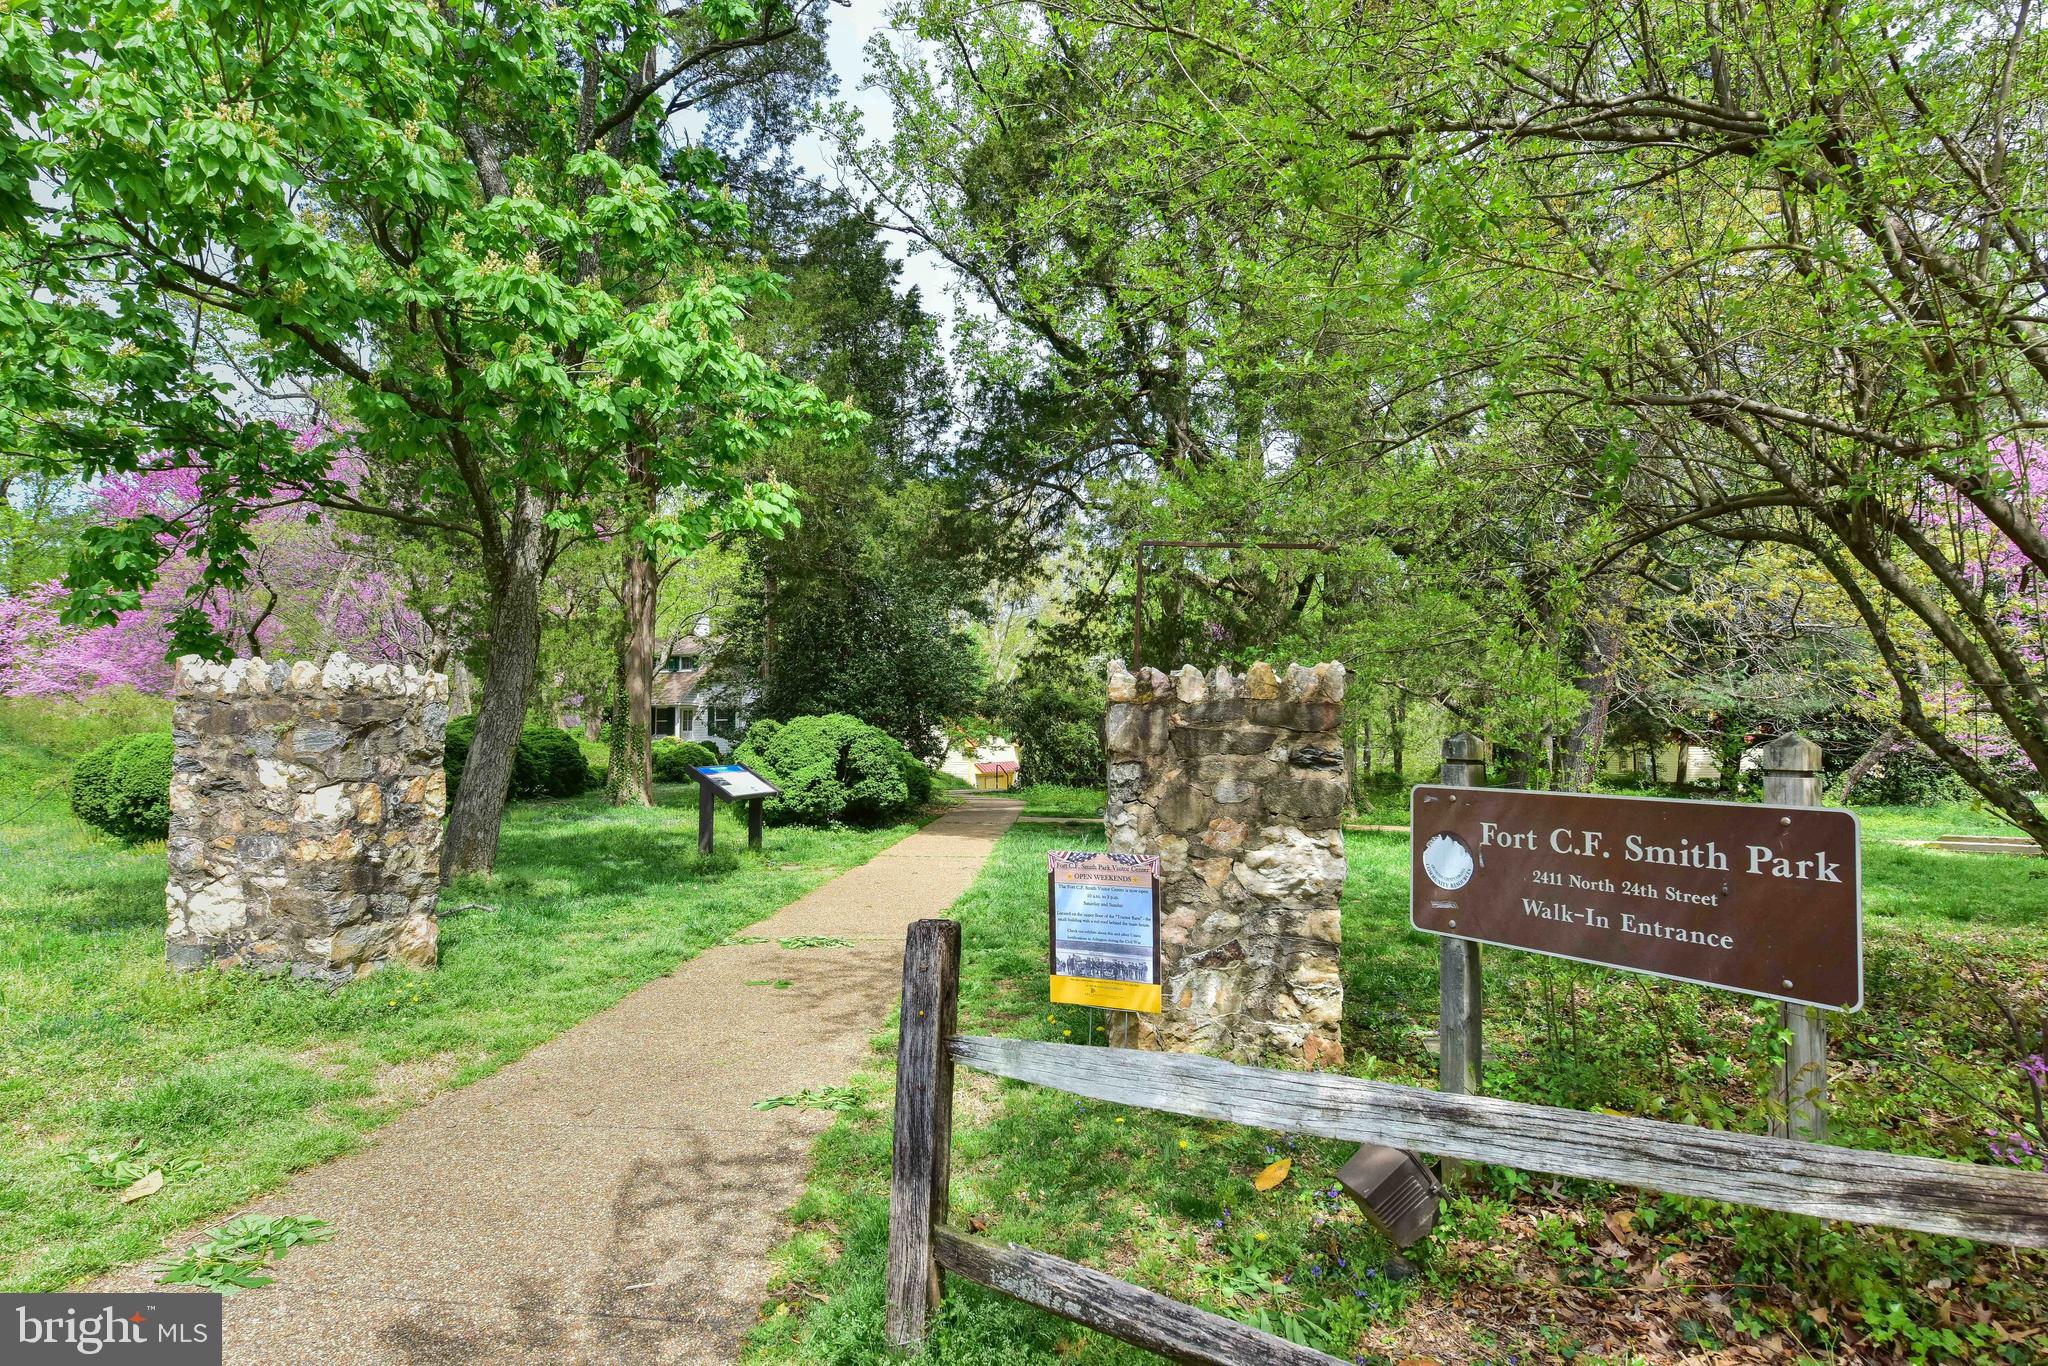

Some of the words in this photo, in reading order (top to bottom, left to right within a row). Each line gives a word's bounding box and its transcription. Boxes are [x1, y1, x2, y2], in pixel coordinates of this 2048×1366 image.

[1479, 821, 1537, 851] Fort
[1550, 828, 1610, 859] C.F.
[1624, 834, 1729, 871] Smith
[1745, 844, 1843, 883] Park
[1093, 874, 1132, 882] WEEKENDS
[1532, 870, 1563, 886] 2411
[1569, 874, 1615, 893] North
[1622, 880, 1658, 899] 24th
[1665, 886, 1718, 907] Street
[1521, 897, 1610, 930] Walk-In
[1620, 912, 1734, 950] Entrance
